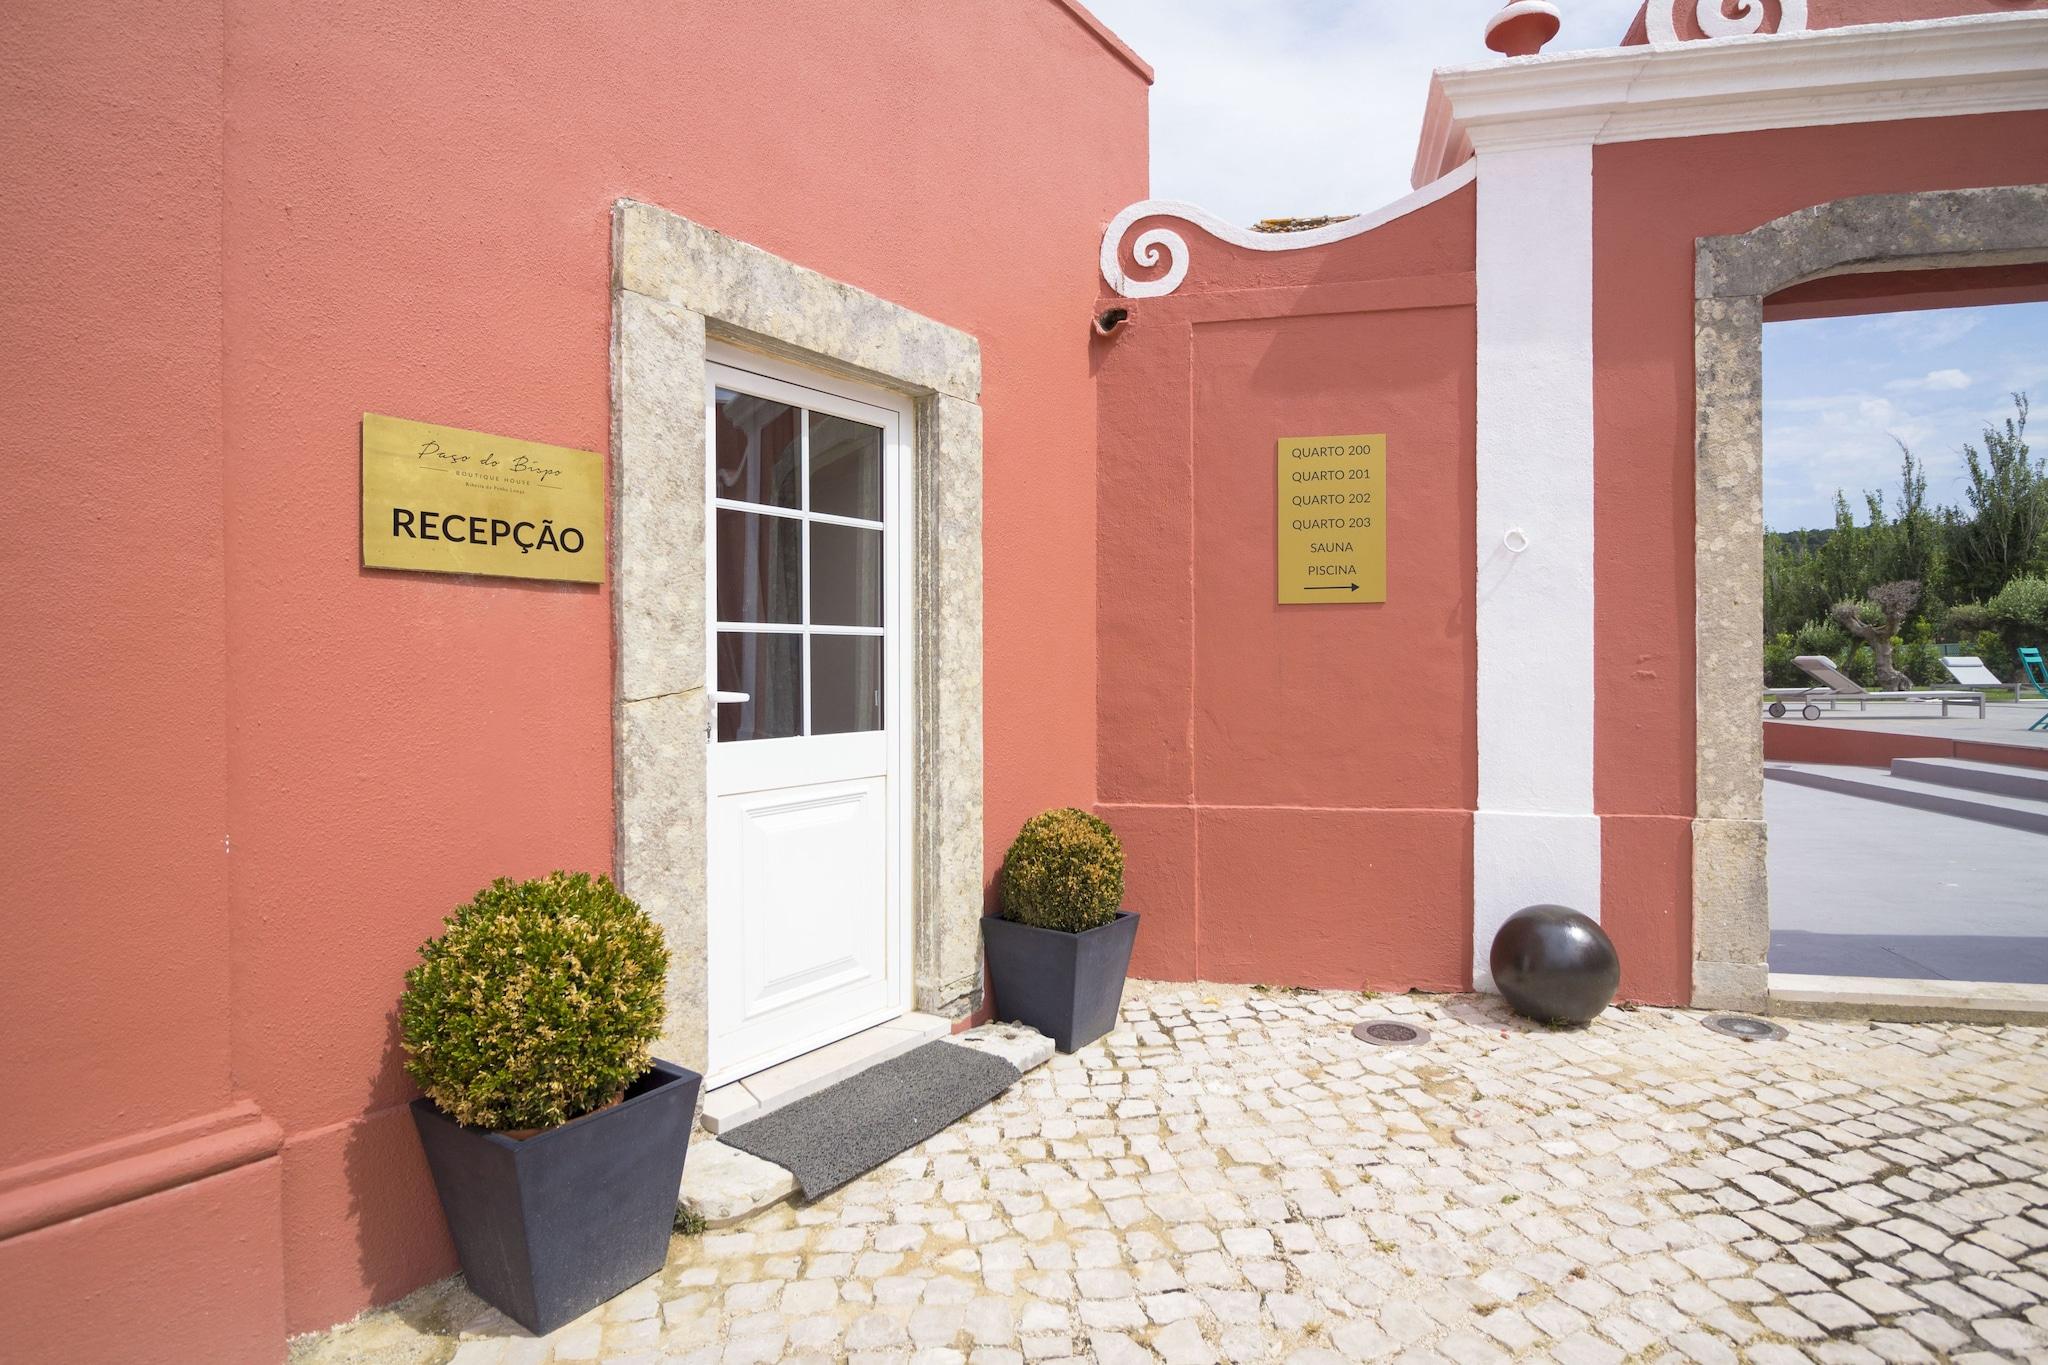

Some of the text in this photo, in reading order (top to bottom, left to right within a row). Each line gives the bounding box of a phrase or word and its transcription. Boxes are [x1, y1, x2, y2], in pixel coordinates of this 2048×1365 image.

[1292, 445, 1371, 459] QUARTO 200
[418, 440, 563, 482] Paço do Bispo
[455, 470, 531, 486] BOUTIQUE HOUSE
[1292, 469, 1371, 483] QUARTO 201
[1292, 493, 1371, 507] QUARTO 202
[392, 507, 585, 554] RECEPÇÃO
[1292, 517, 1371, 531] QUARTO 203
[1310, 542, 1354, 553] SAUNA
[1308, 564, 1357, 576] PISCINA
